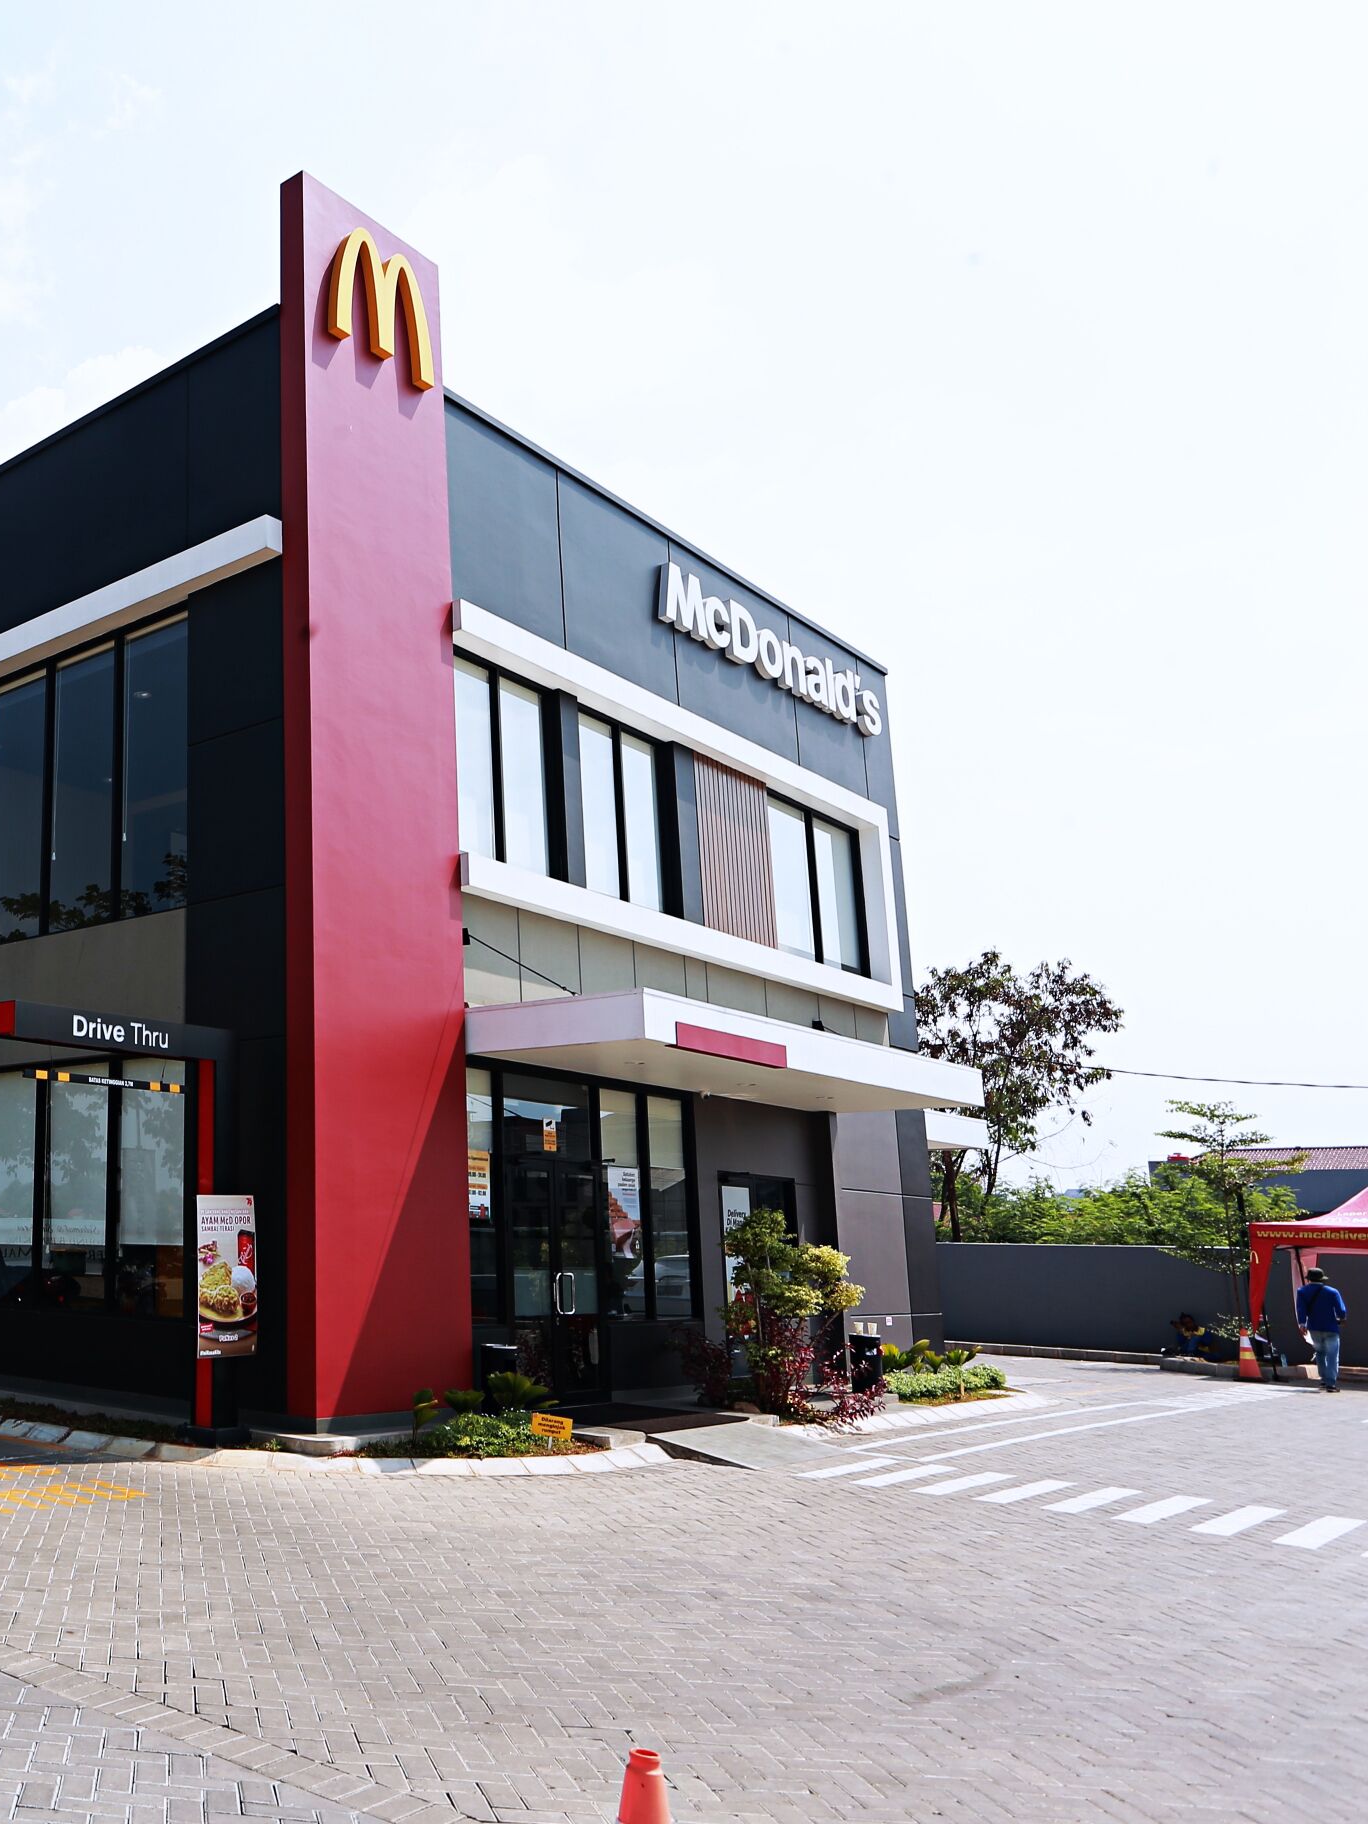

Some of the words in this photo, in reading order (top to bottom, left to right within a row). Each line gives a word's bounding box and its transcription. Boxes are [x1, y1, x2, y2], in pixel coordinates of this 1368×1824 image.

[658, 561, 882, 738] McDonald's
[72, 1014, 125, 1043] Drive
[130, 1022, 169, 1049] Thru
[727, 1208, 746, 1219] Delivery
[201, 1216, 219, 1225] AYAM
[220, 1216, 233, 1225] McD
[234, 1216, 251, 1225] OPOR
[541, 1416, 563, 1425] Dilarang
[538, 1422, 565, 1430] menginjak
